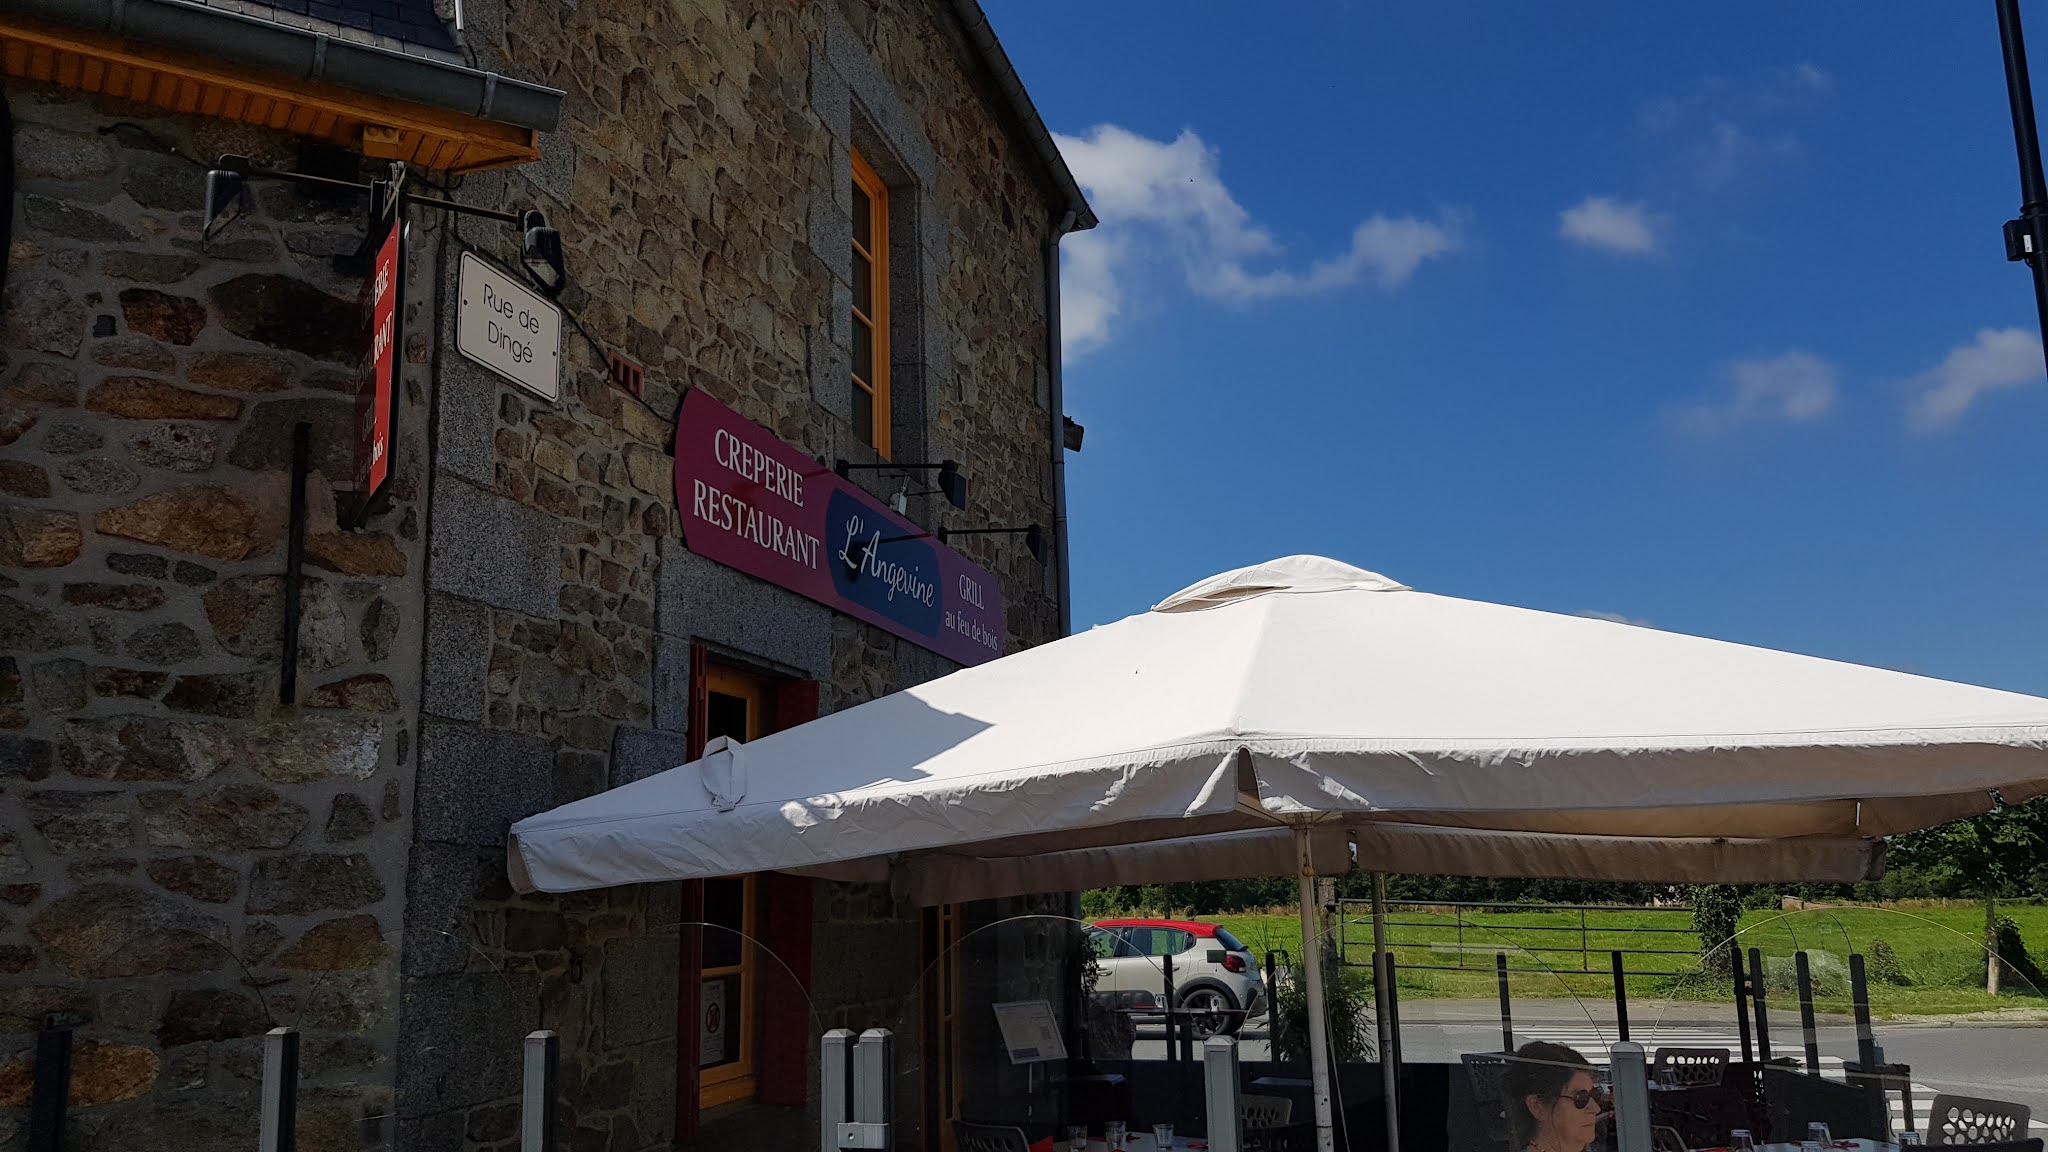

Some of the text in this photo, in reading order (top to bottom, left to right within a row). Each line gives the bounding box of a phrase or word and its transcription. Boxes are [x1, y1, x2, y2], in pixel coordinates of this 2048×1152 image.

[483, 282, 540, 335] Rue de
[487, 319, 533, 364] Dingé
[372, 431, 384, 465] bois
[714, 428, 804, 508] CREPERIE
[693, 478, 820, 570] RESTAURANT
[838, 514, 935, 609] L'Angevine
[958, 573, 985, 610] GRILL
[945, 609, 998, 651] au feu de bois
